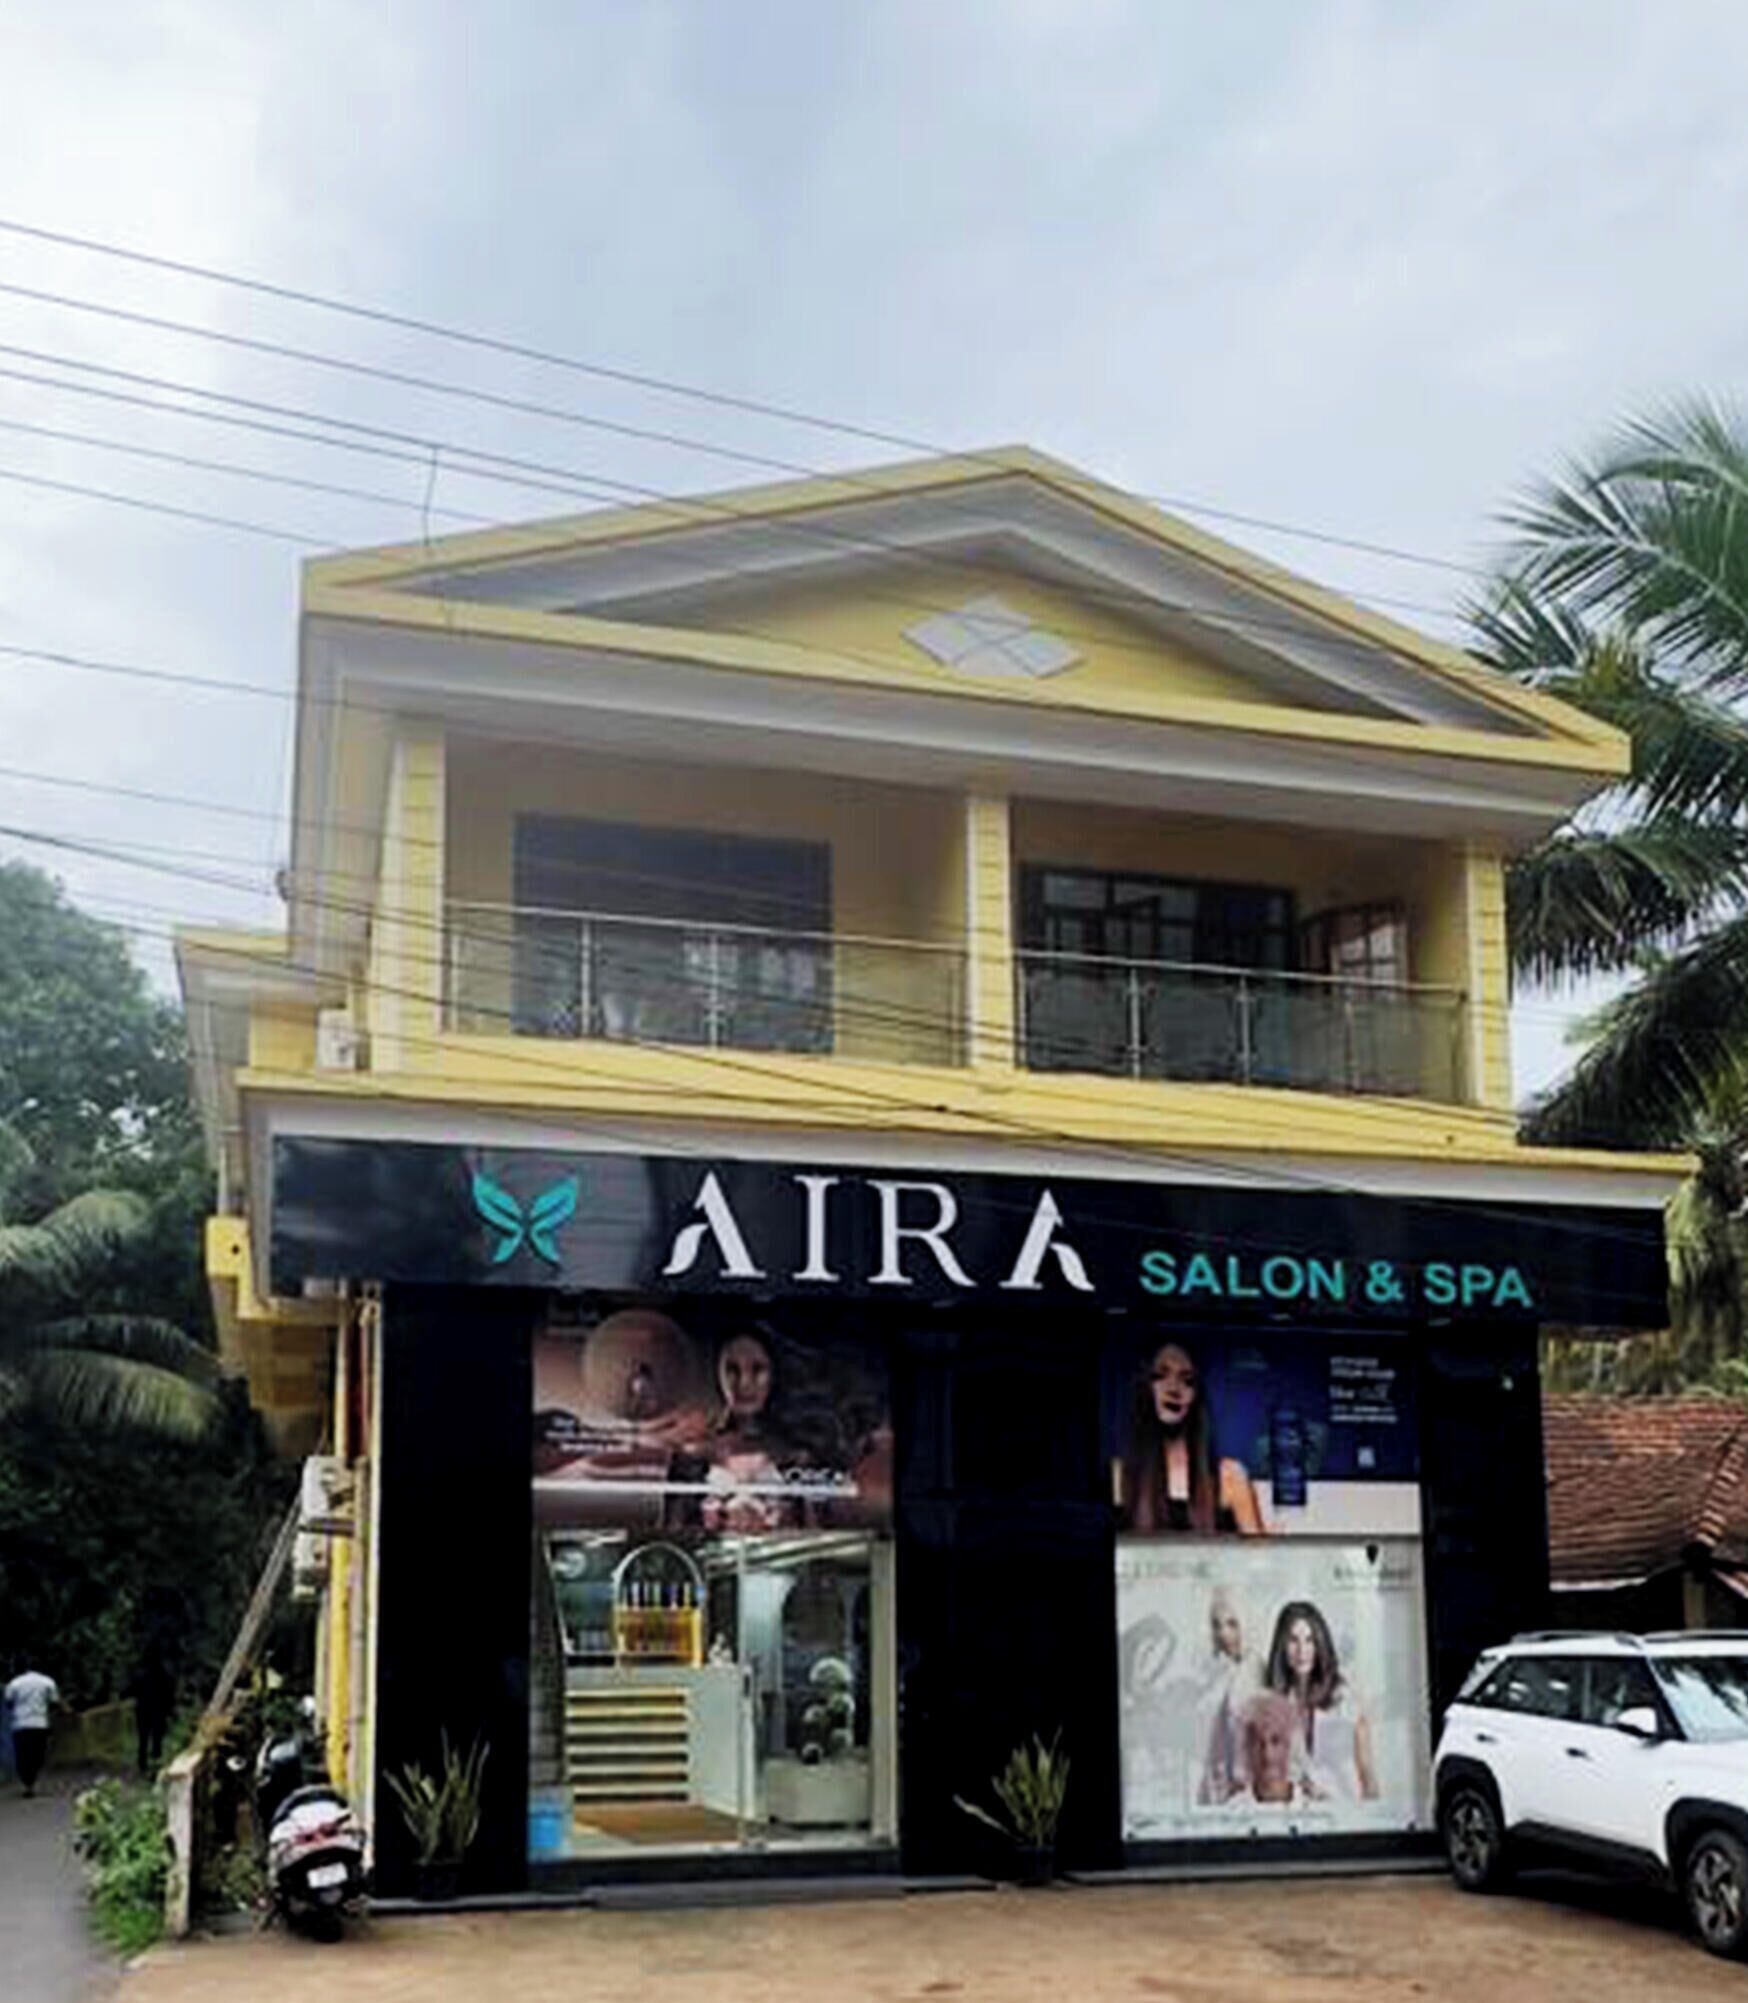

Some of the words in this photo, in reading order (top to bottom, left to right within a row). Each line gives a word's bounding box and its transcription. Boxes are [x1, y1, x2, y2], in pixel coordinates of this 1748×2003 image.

[662, 1170, 1095, 1291] AIRA
[1139, 1251, 1345, 1301] SALON
[1364, 1260, 1405, 1302] &
[1423, 1262, 1533, 1307] SPA
